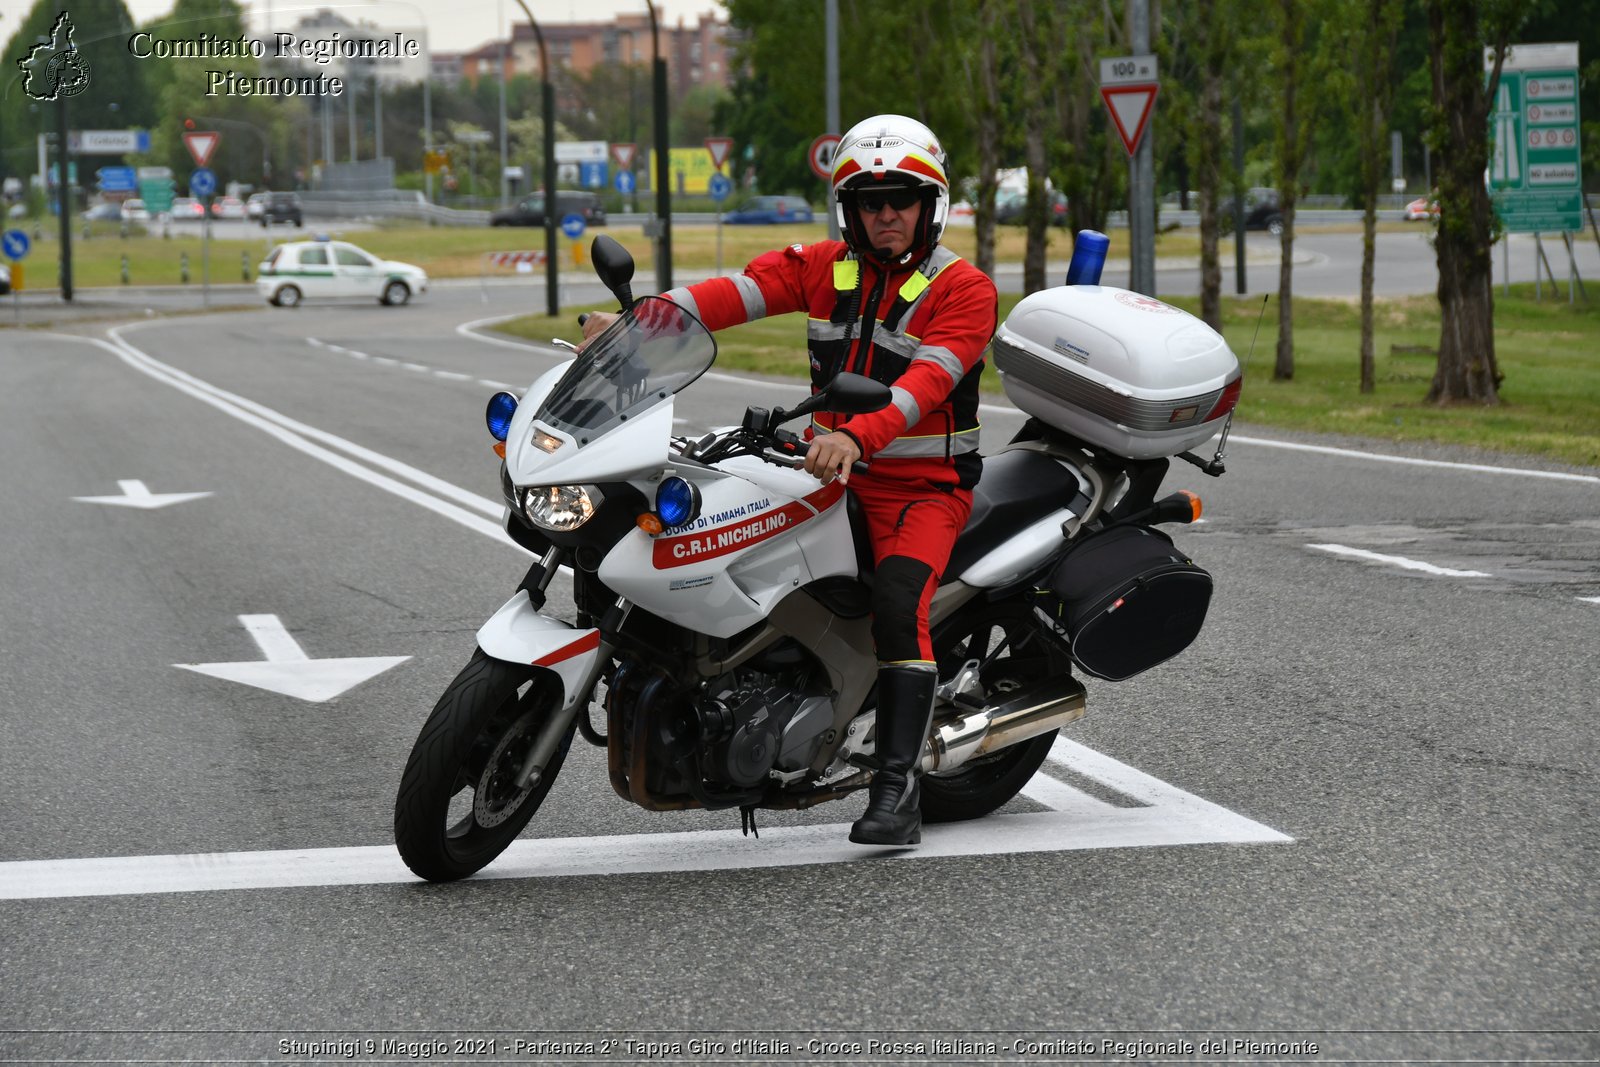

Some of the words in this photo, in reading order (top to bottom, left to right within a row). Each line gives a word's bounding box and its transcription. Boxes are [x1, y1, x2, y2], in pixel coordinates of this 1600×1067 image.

[1111, 61, 1136, 77] 100
[665, 522, 695, 537] DONO
[697, 518, 709, 529] DI
[709, 505, 747, 525] YAMAHA
[747, 498, 771, 514] ITALIA
[673, 536, 717, 559] C.R.I.
[717, 512, 788, 549] NICHELINO
